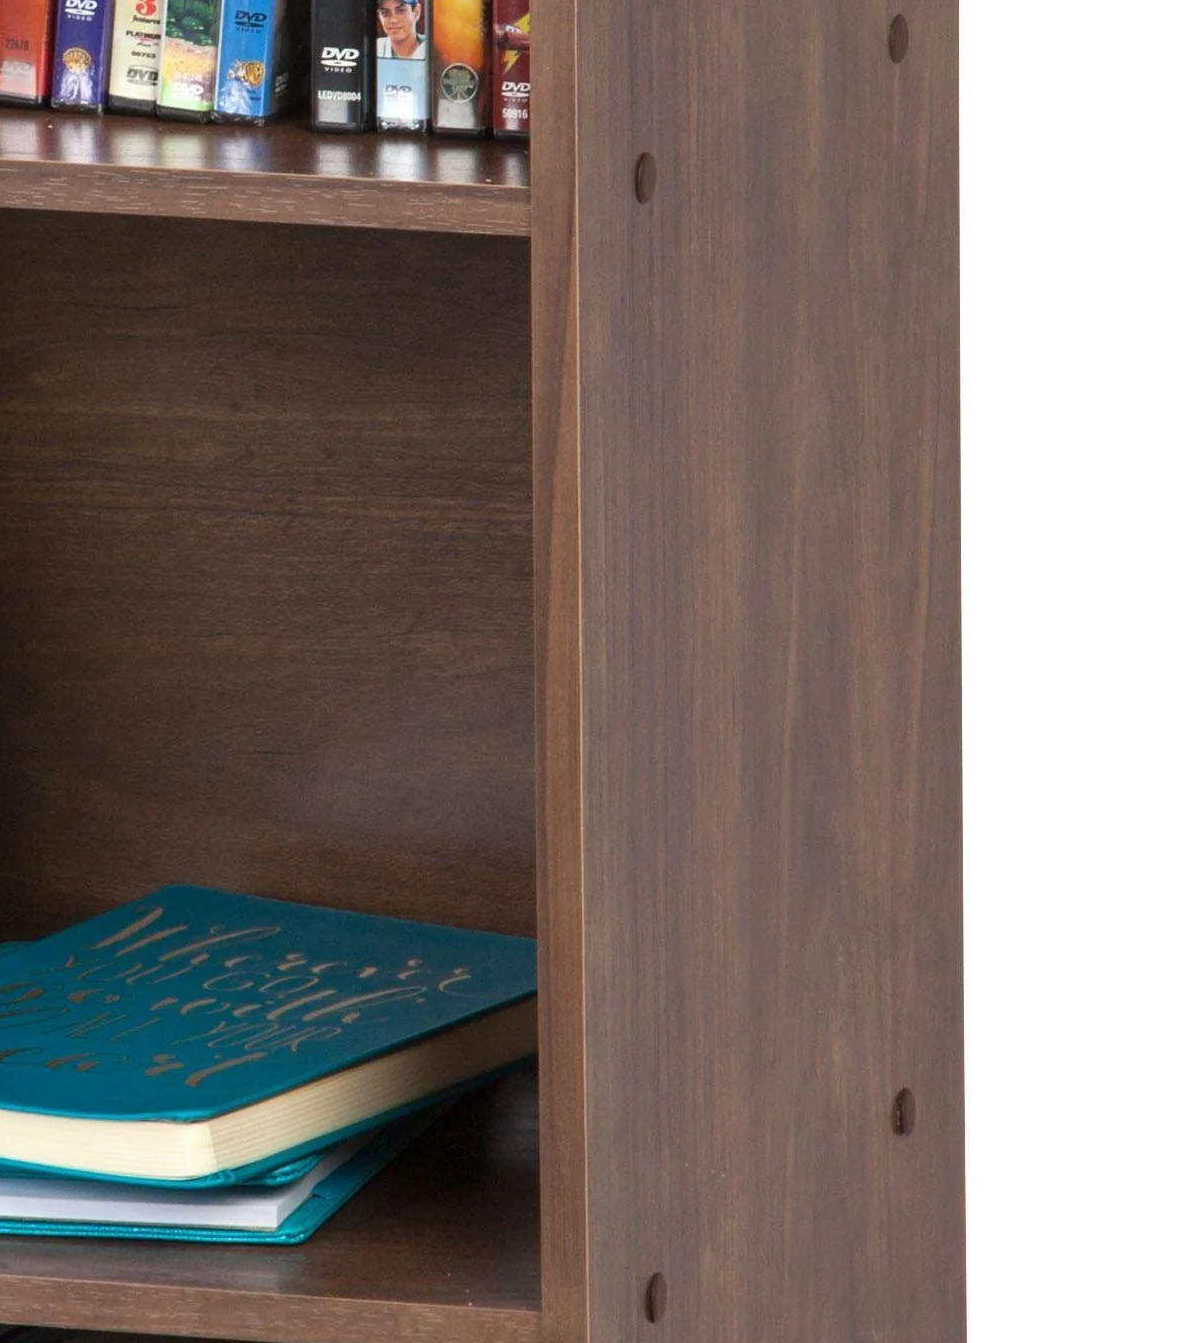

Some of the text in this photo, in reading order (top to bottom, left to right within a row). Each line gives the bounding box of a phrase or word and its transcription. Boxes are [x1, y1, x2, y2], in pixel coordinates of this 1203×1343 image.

[235, 10, 267, 22] DVD
[321, 47, 360, 60] DVD
[501, 81, 530, 93] DVD
